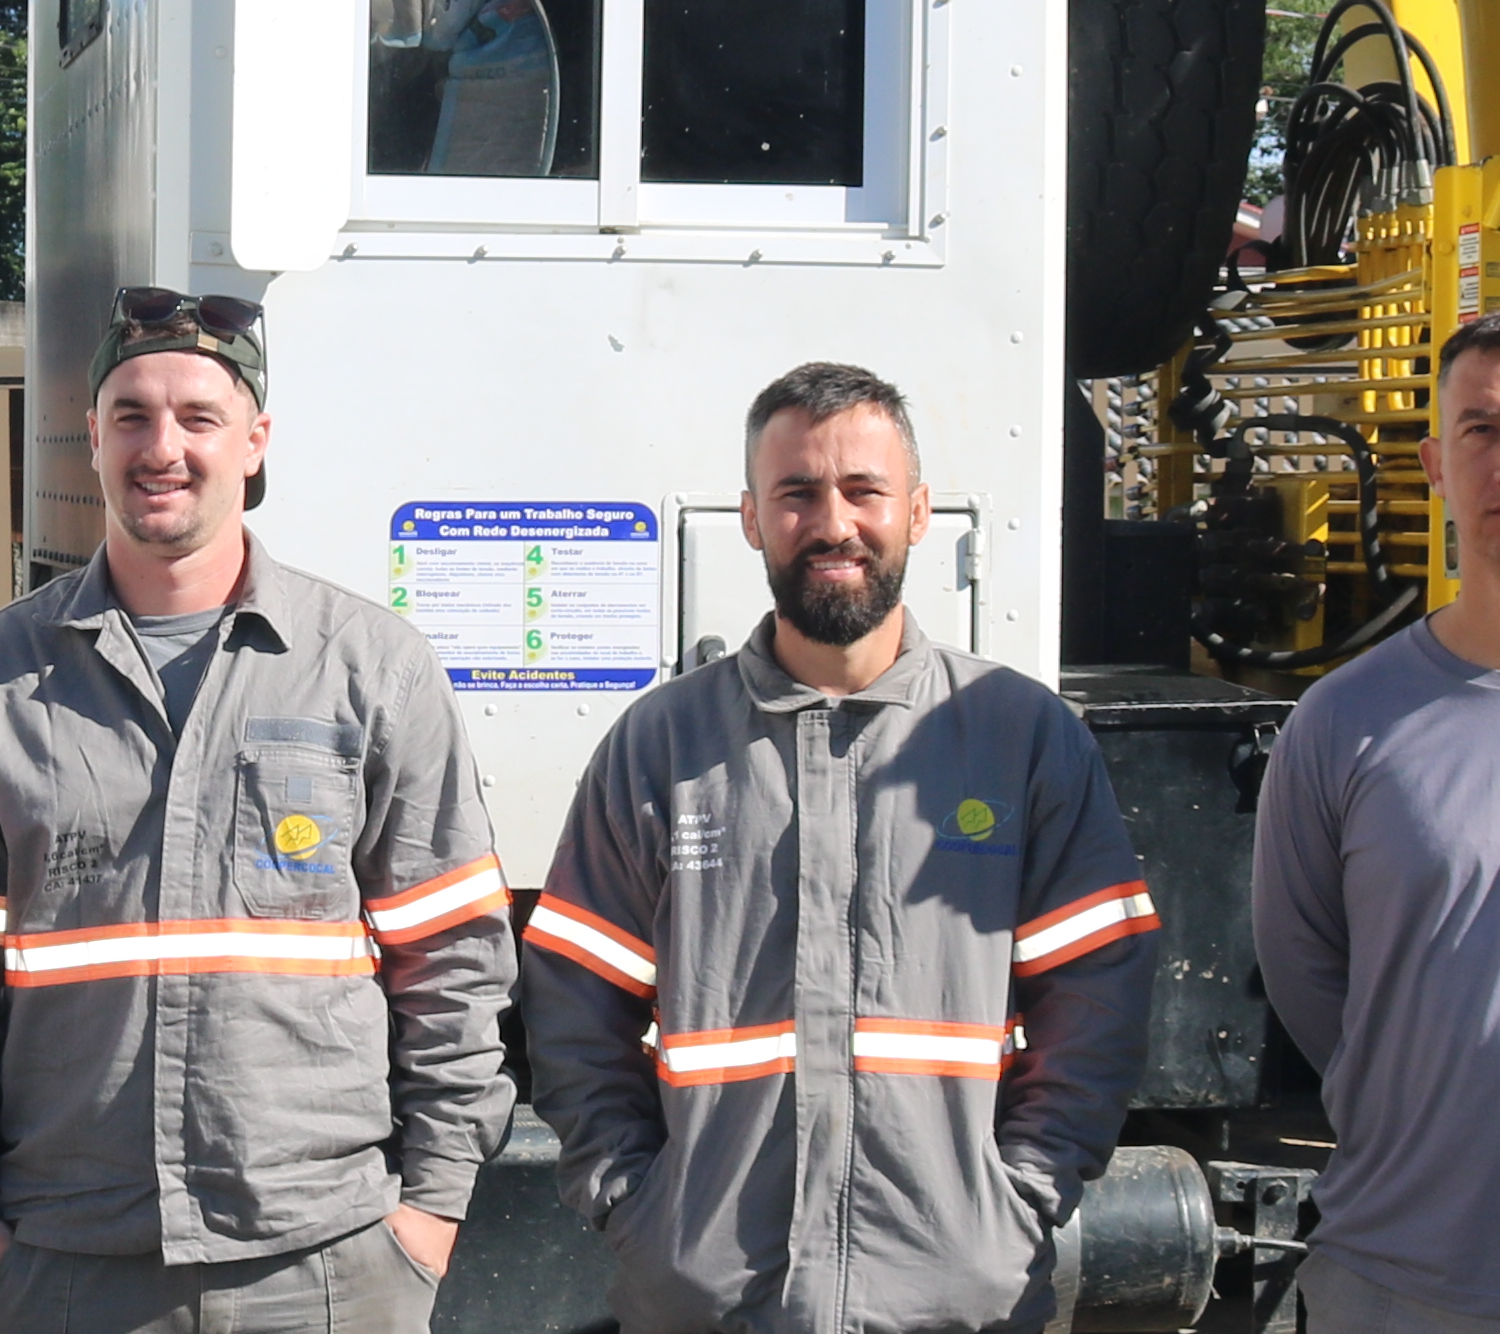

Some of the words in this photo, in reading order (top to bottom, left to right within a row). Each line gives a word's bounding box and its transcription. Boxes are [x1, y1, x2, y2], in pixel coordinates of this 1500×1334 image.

[414, 508, 462, 522] Regras
[466, 508, 497, 520] Para
[500, 511, 521, 520] um
[524, 508, 584, 520] Trabalho
[586, 508, 635, 523] Seguro
[439, 525, 471, 537] Com
[473, 525, 507, 537] Rede
[511, 525, 609, 540] Desenergizada
[392, 544, 405, 565] 1
[416, 547, 458, 557] Desligar
[526, 545, 543, 565] 4
[551, 547, 583, 556] Testar
[391, 587, 408, 607] 2
[416, 590, 461, 599] Bloquear
[526, 587, 543, 607] 5
[551, 590, 588, 598] Aterrar
[424, 632, 460, 640] nalizar
[526, 629, 543, 649] 6
[550, 632, 594, 642] Proteger
[472, 670, 506, 680] Evite
[509, 670, 576, 680] Acidentes
[677, 812, 712, 825] ATPV
[55, 829, 86, 844] ATPV
[671, 844, 709, 857] RISCO
[710, 842, 719, 854] 2
[48, 860, 87, 878] RISCO
